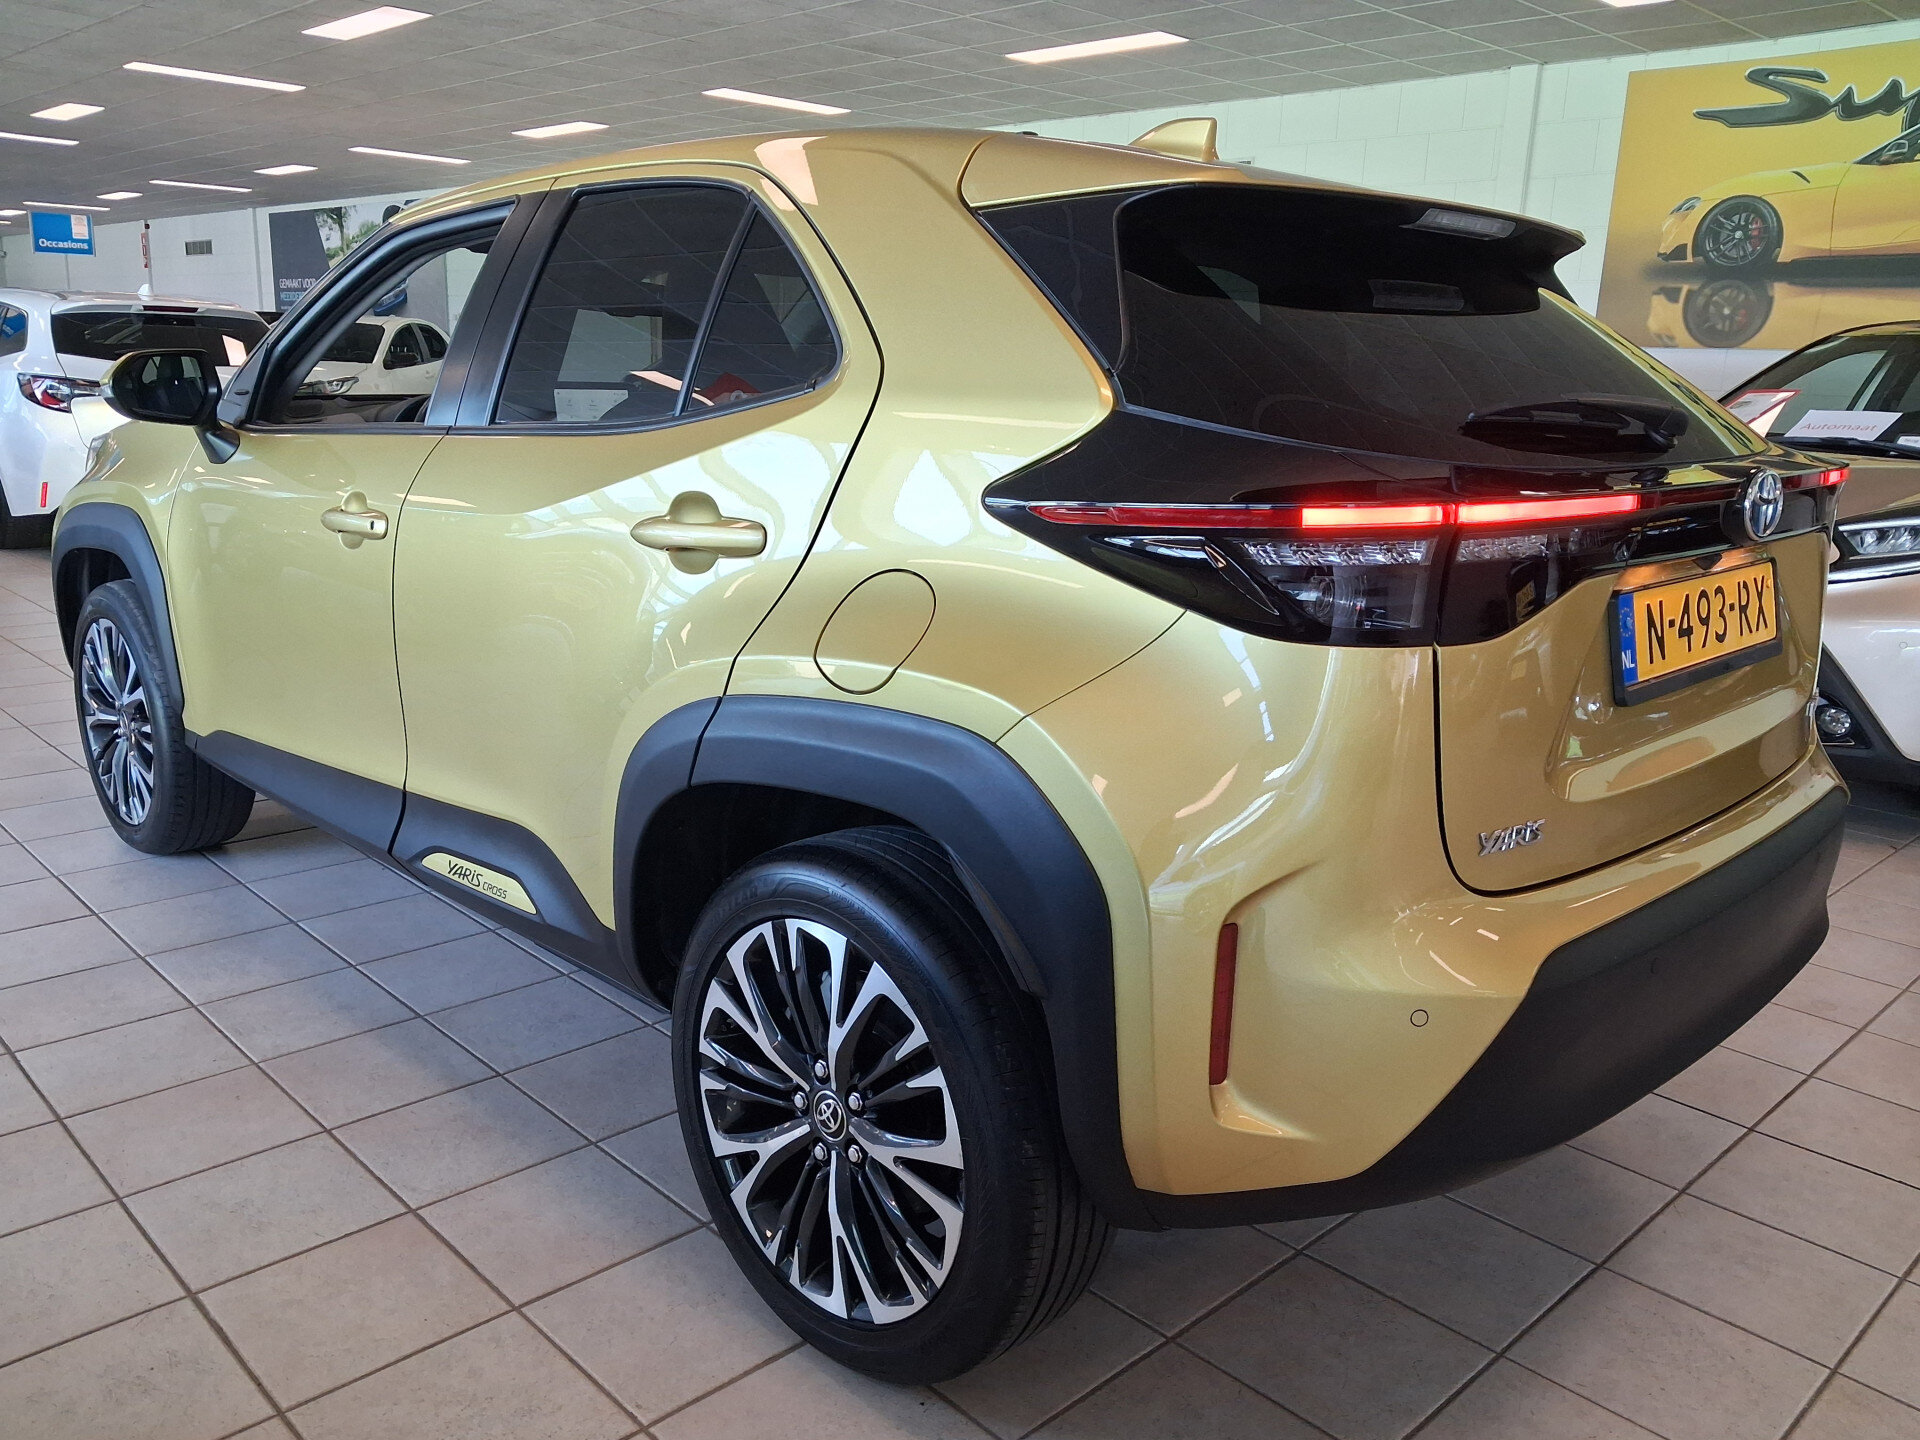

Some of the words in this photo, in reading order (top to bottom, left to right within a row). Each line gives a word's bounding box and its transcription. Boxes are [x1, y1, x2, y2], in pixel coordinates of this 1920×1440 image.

[1693, 66, 1920, 133] Su
[39, 238, 89, 249] Occasions
[279, 278, 302, 289] GEMAAKT
[1800, 422, 1877, 432] Automaat
[1646, 574, 1769, 665] N-493-RX
[1621, 651, 1635, 670] NL
[482, 881, 508, 899] CROSS
